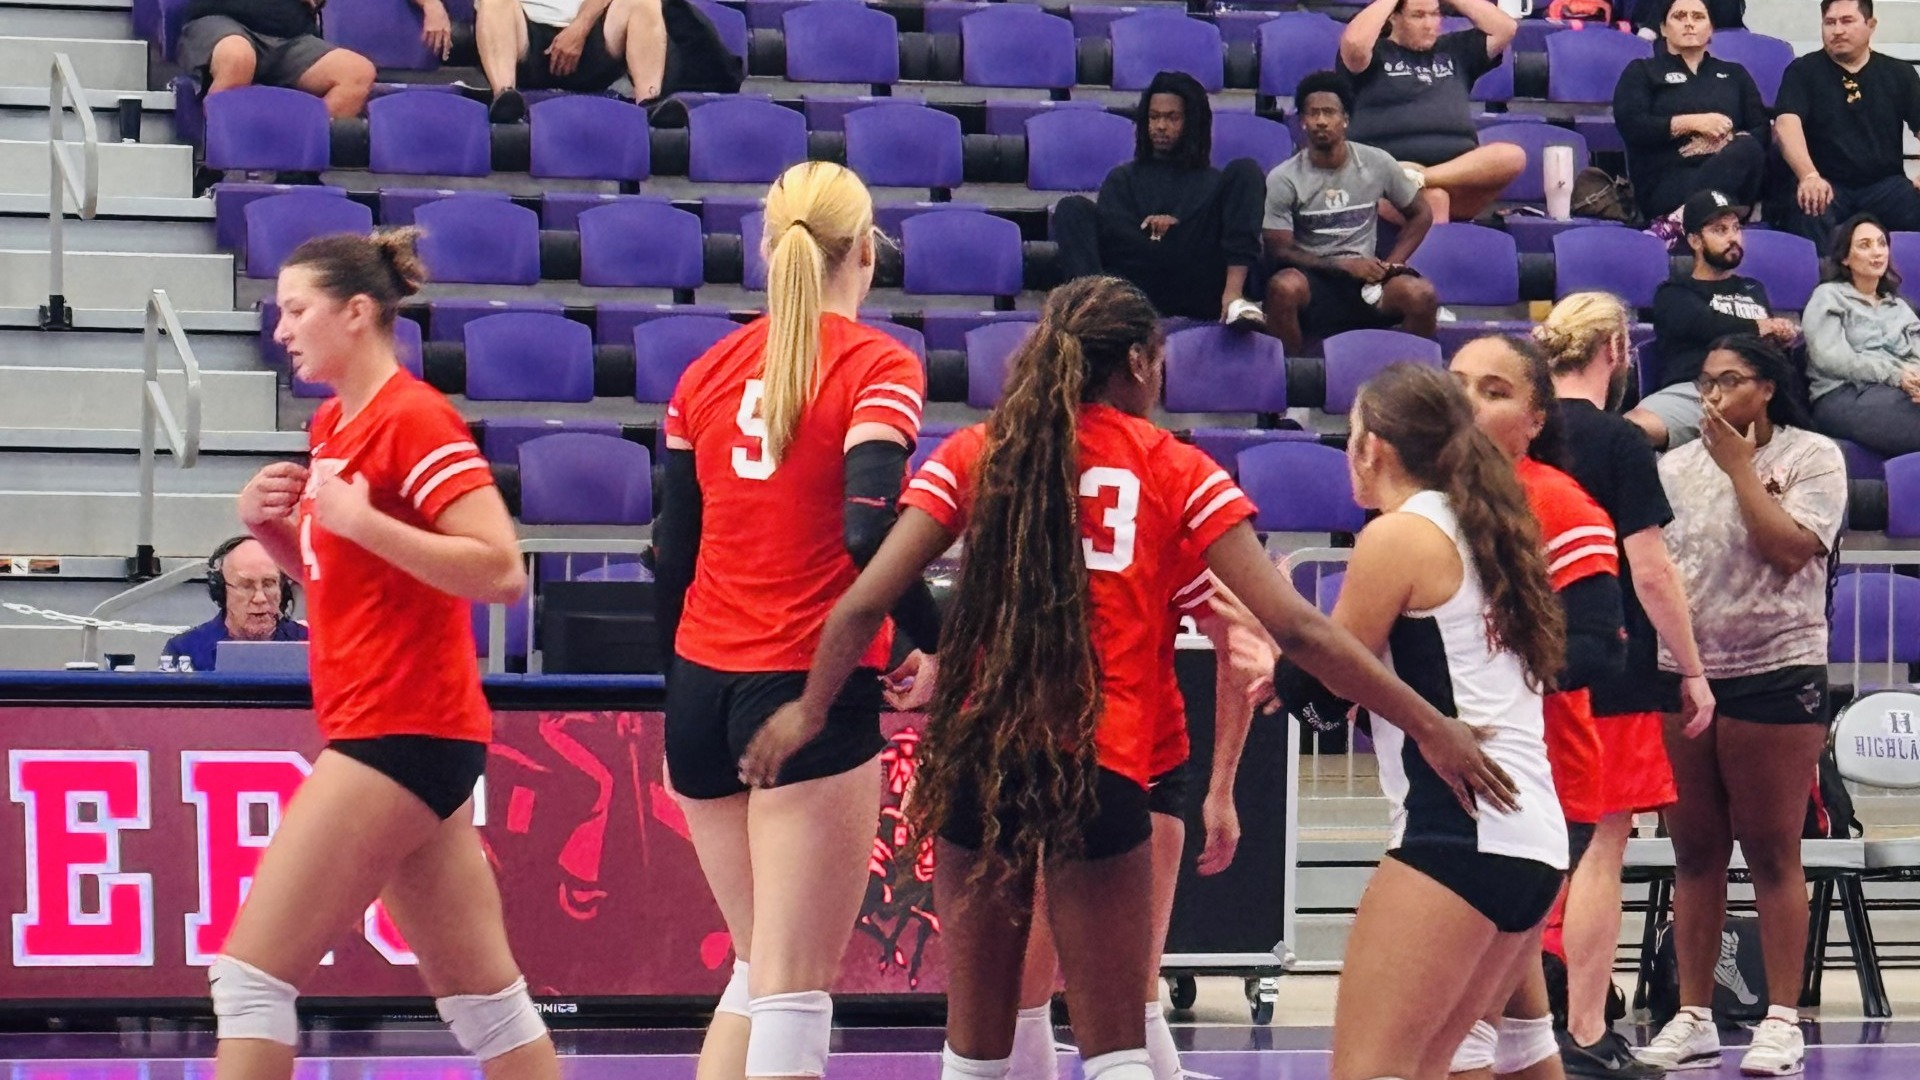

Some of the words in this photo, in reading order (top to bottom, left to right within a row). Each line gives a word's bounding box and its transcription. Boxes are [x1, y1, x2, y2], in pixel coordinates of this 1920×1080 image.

[731, 379, 777, 480] 5
[1079, 466, 1141, 573] 3
[1888, 711, 1914, 735] H
